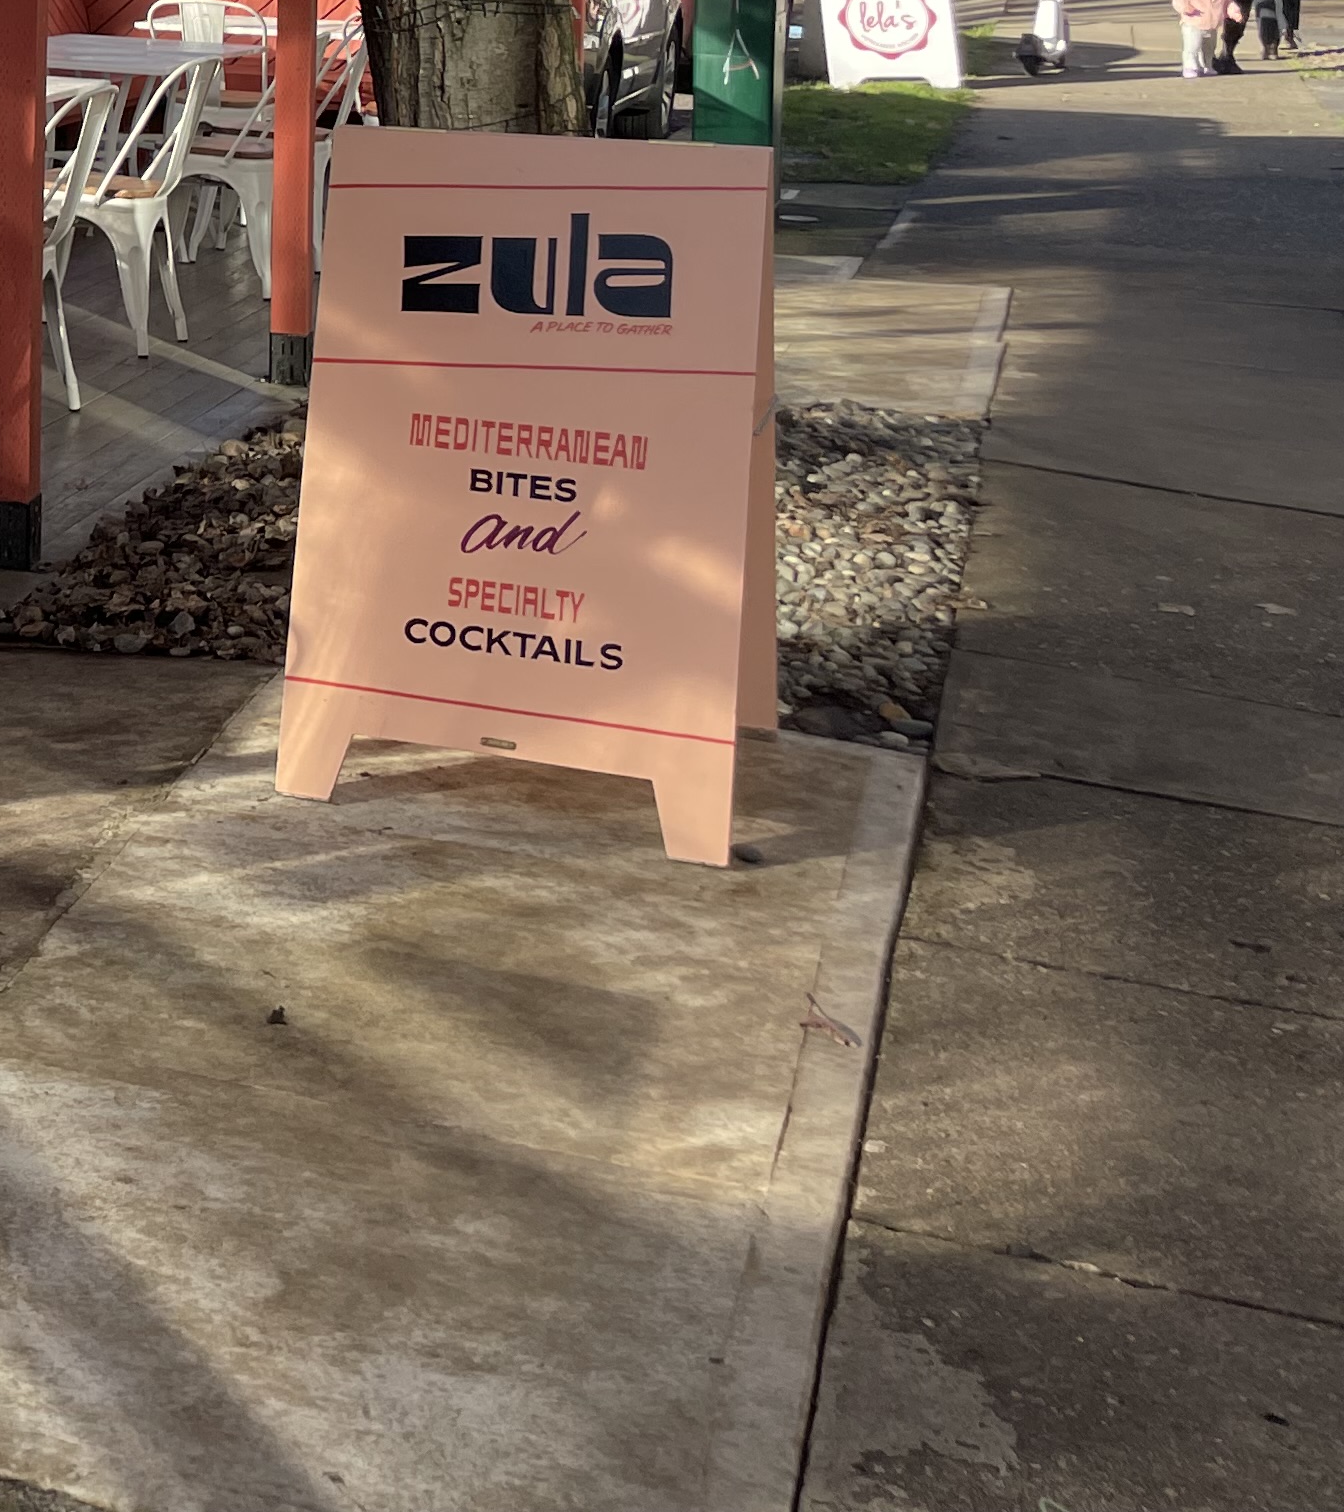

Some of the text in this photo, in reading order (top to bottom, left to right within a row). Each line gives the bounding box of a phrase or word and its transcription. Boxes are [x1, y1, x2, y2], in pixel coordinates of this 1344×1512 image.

[859, 0, 917, 33] lela's
[401, 212, 673, 318] zula
[530, 321, 673, 336] A PLACE TO GATHER
[409, 413, 649, 471] MEDITERRANEAN
[469, 468, 577, 503] BITES
[461, 510, 588, 555] and
[447, 576, 586, 624] SPECIALTY
[404, 617, 624, 671] COCKTAILS
